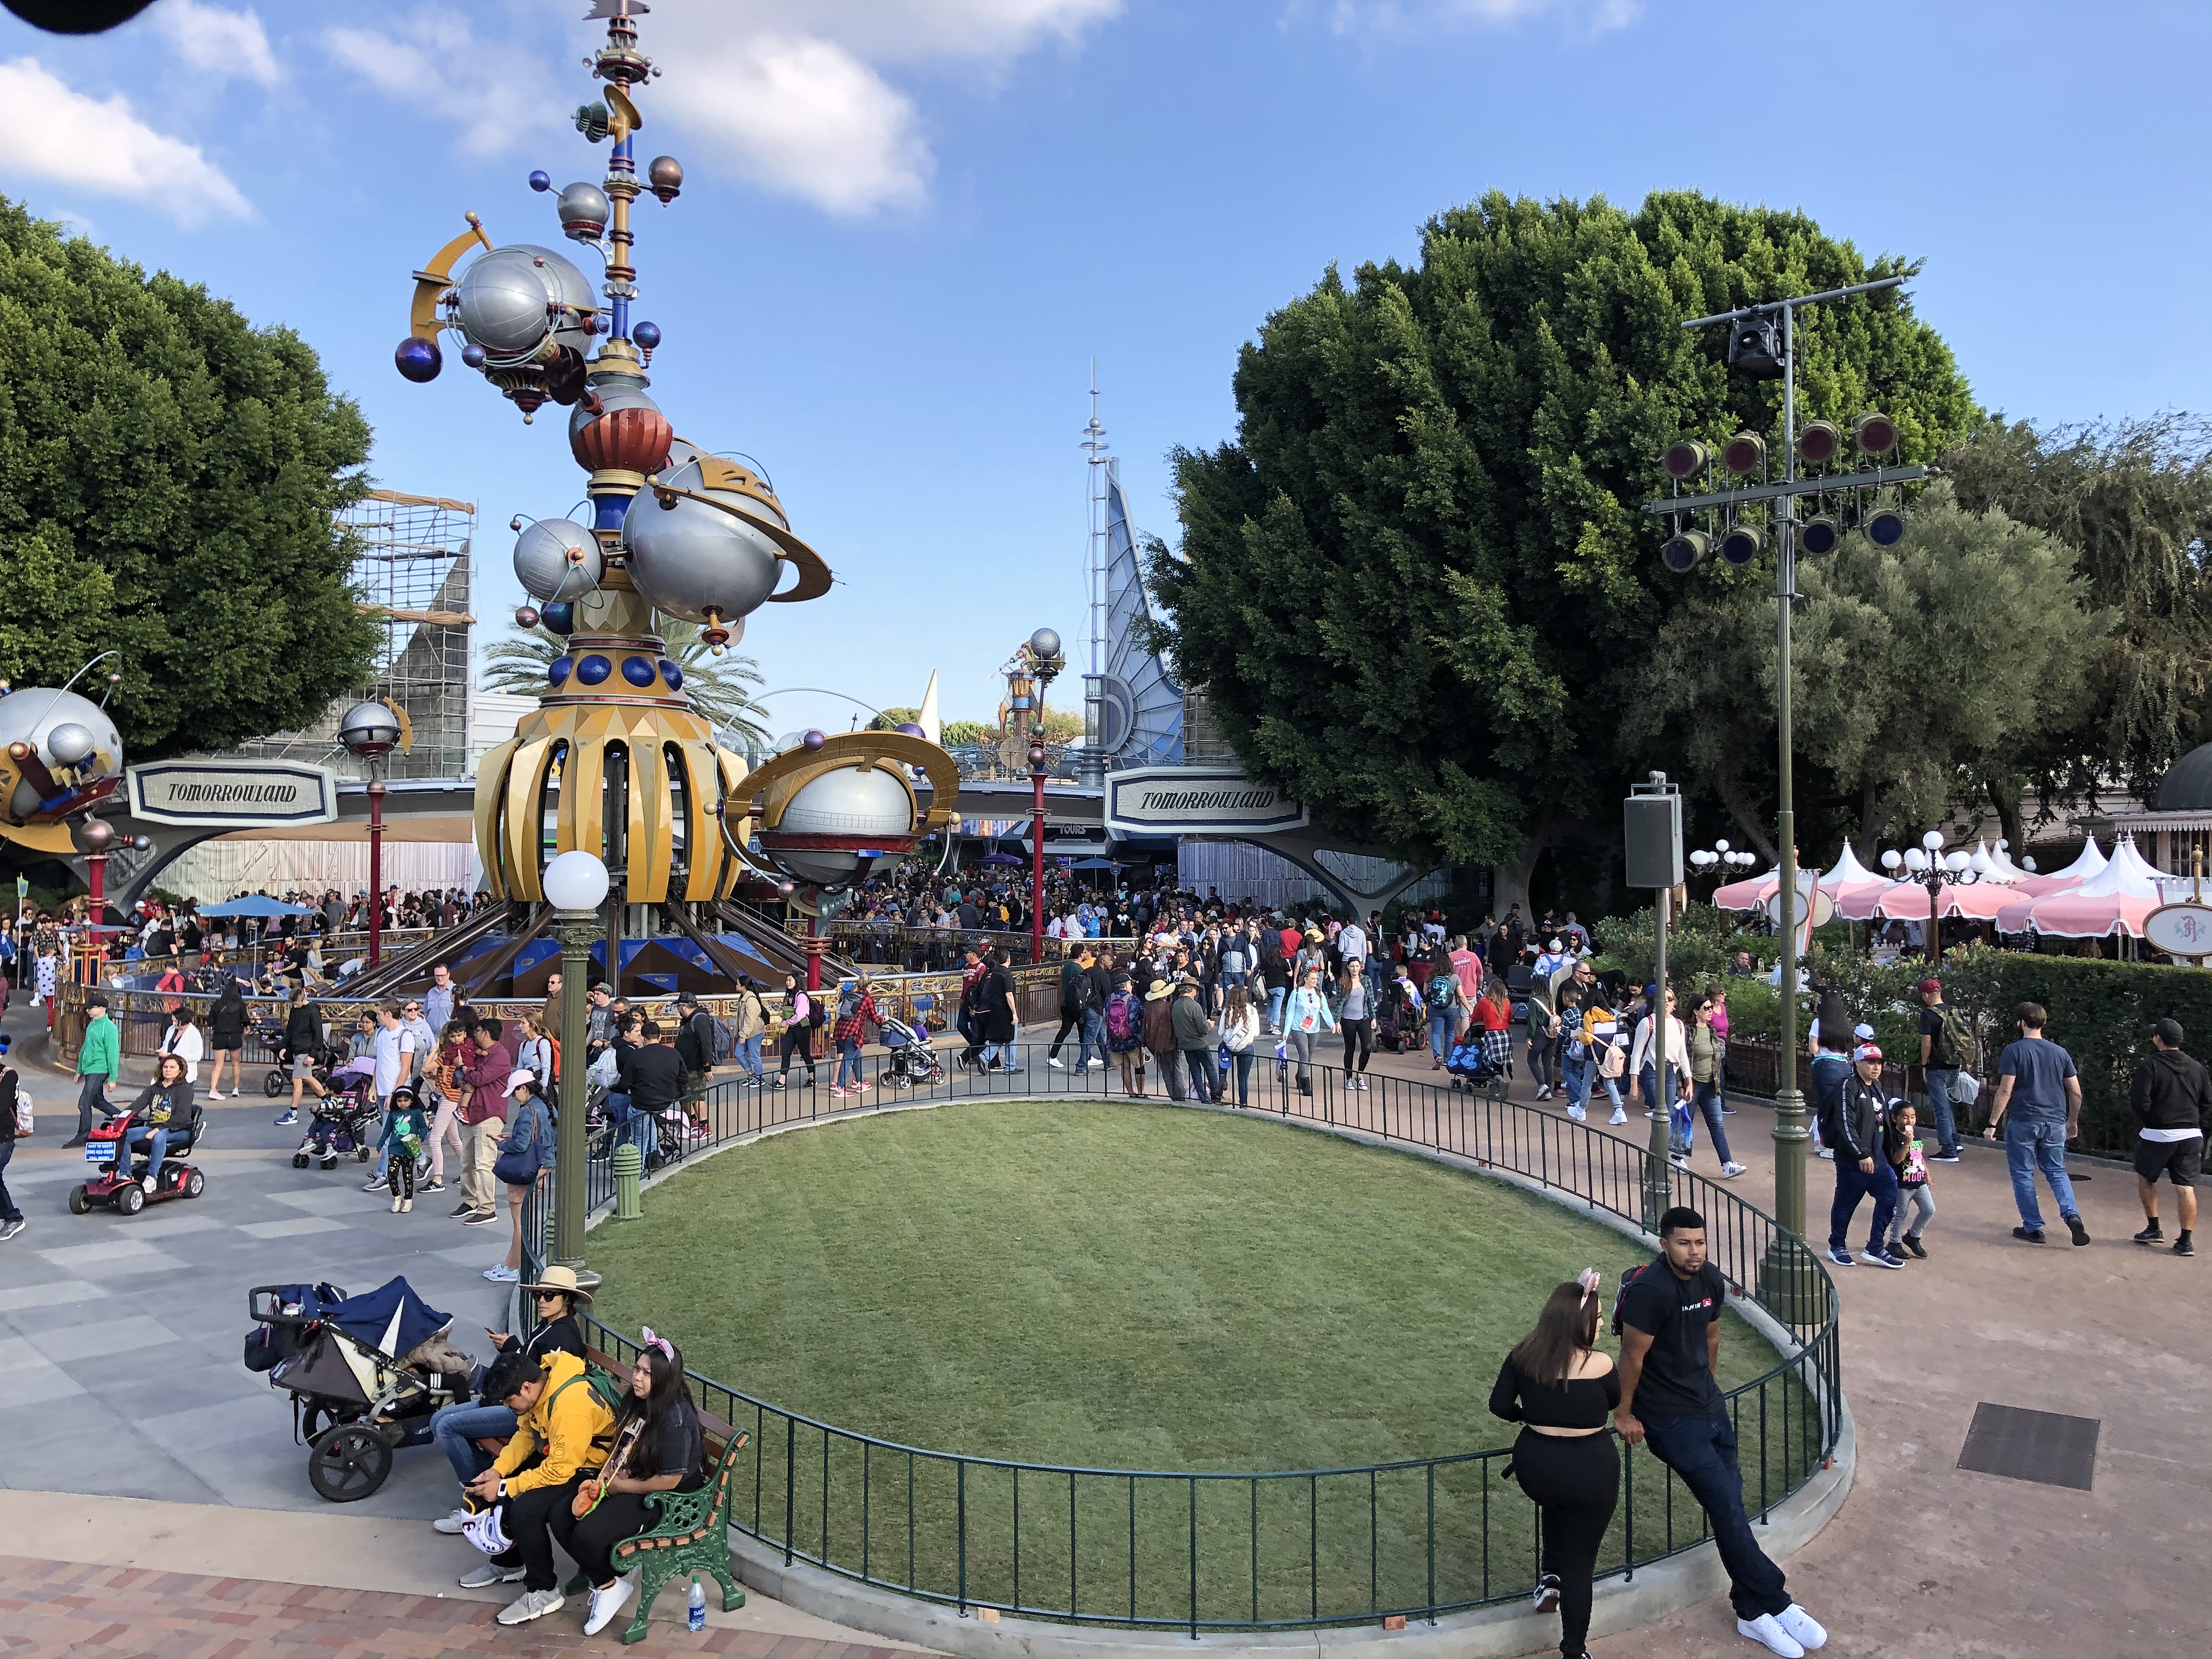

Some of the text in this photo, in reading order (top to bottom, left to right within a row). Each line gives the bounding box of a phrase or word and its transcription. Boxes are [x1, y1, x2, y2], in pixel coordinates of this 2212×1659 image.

[168, 783, 297, 802] TOMORROWLAND
[1140, 791, 1274, 809] TOMORROWLAND
[1059, 825, 1086, 834] TOURS
